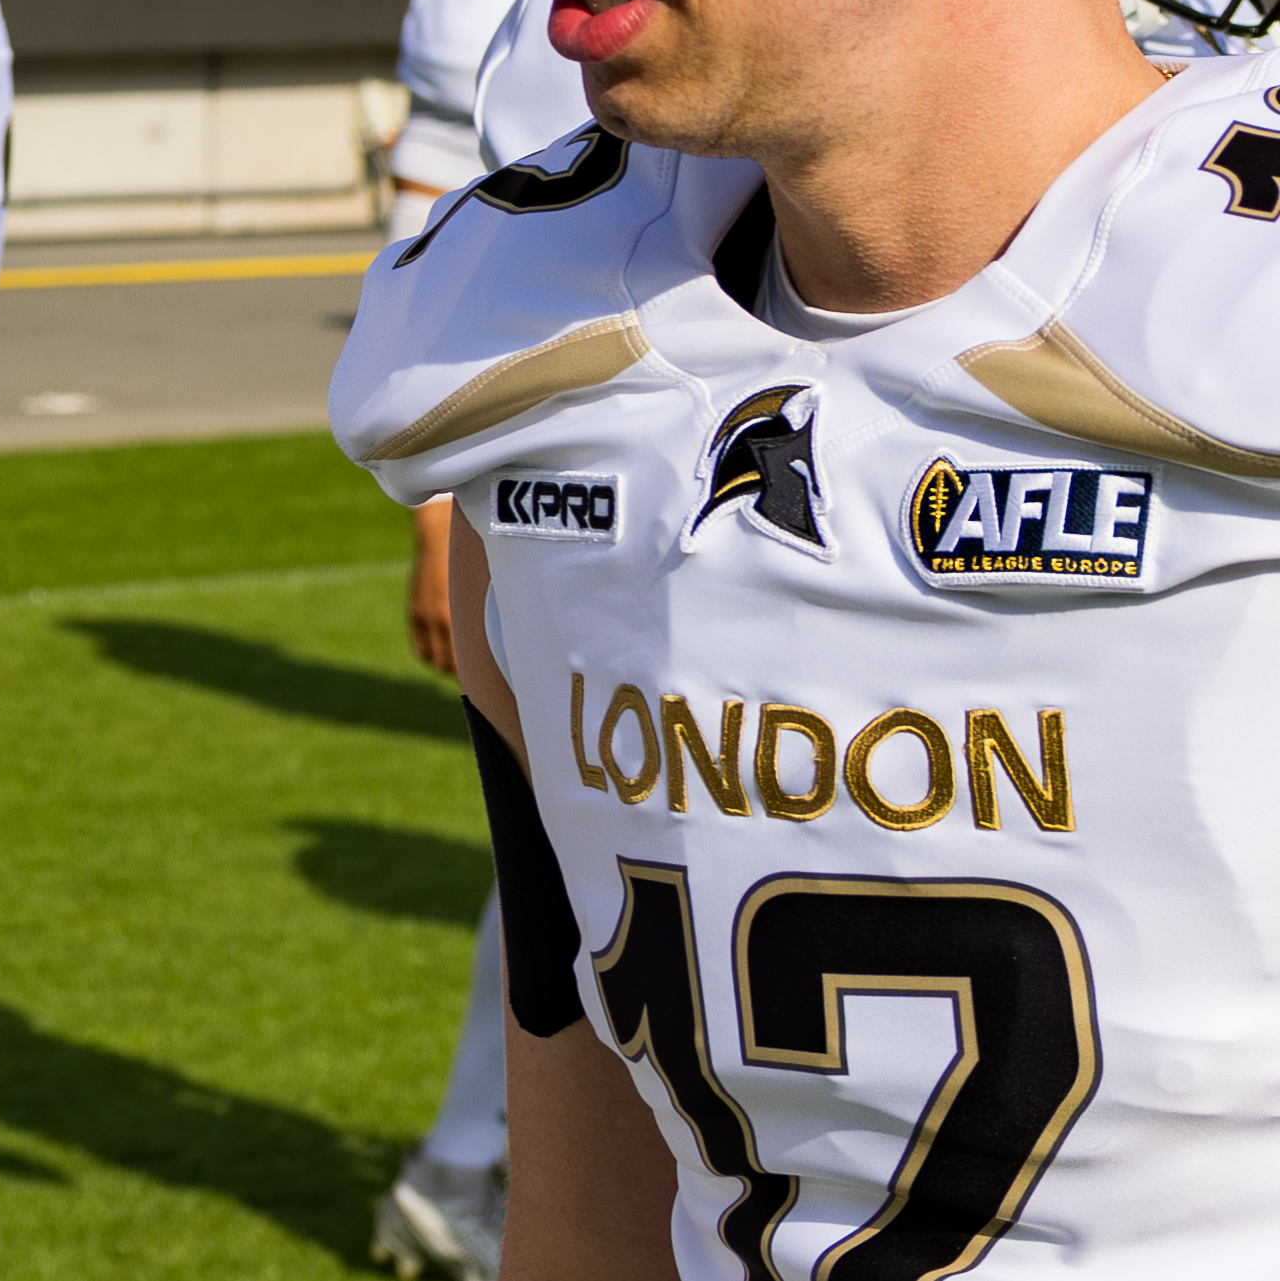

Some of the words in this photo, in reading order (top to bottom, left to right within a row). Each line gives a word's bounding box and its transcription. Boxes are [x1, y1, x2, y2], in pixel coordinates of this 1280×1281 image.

[933, 470, 1146, 558] AFLE
[931, 556, 966, 572] THE
[971, 555, 1043, 572] LEAGUE
[1051, 557, 1139, 576] EUROPE
[569, 669, 1077, 834] LONDON
